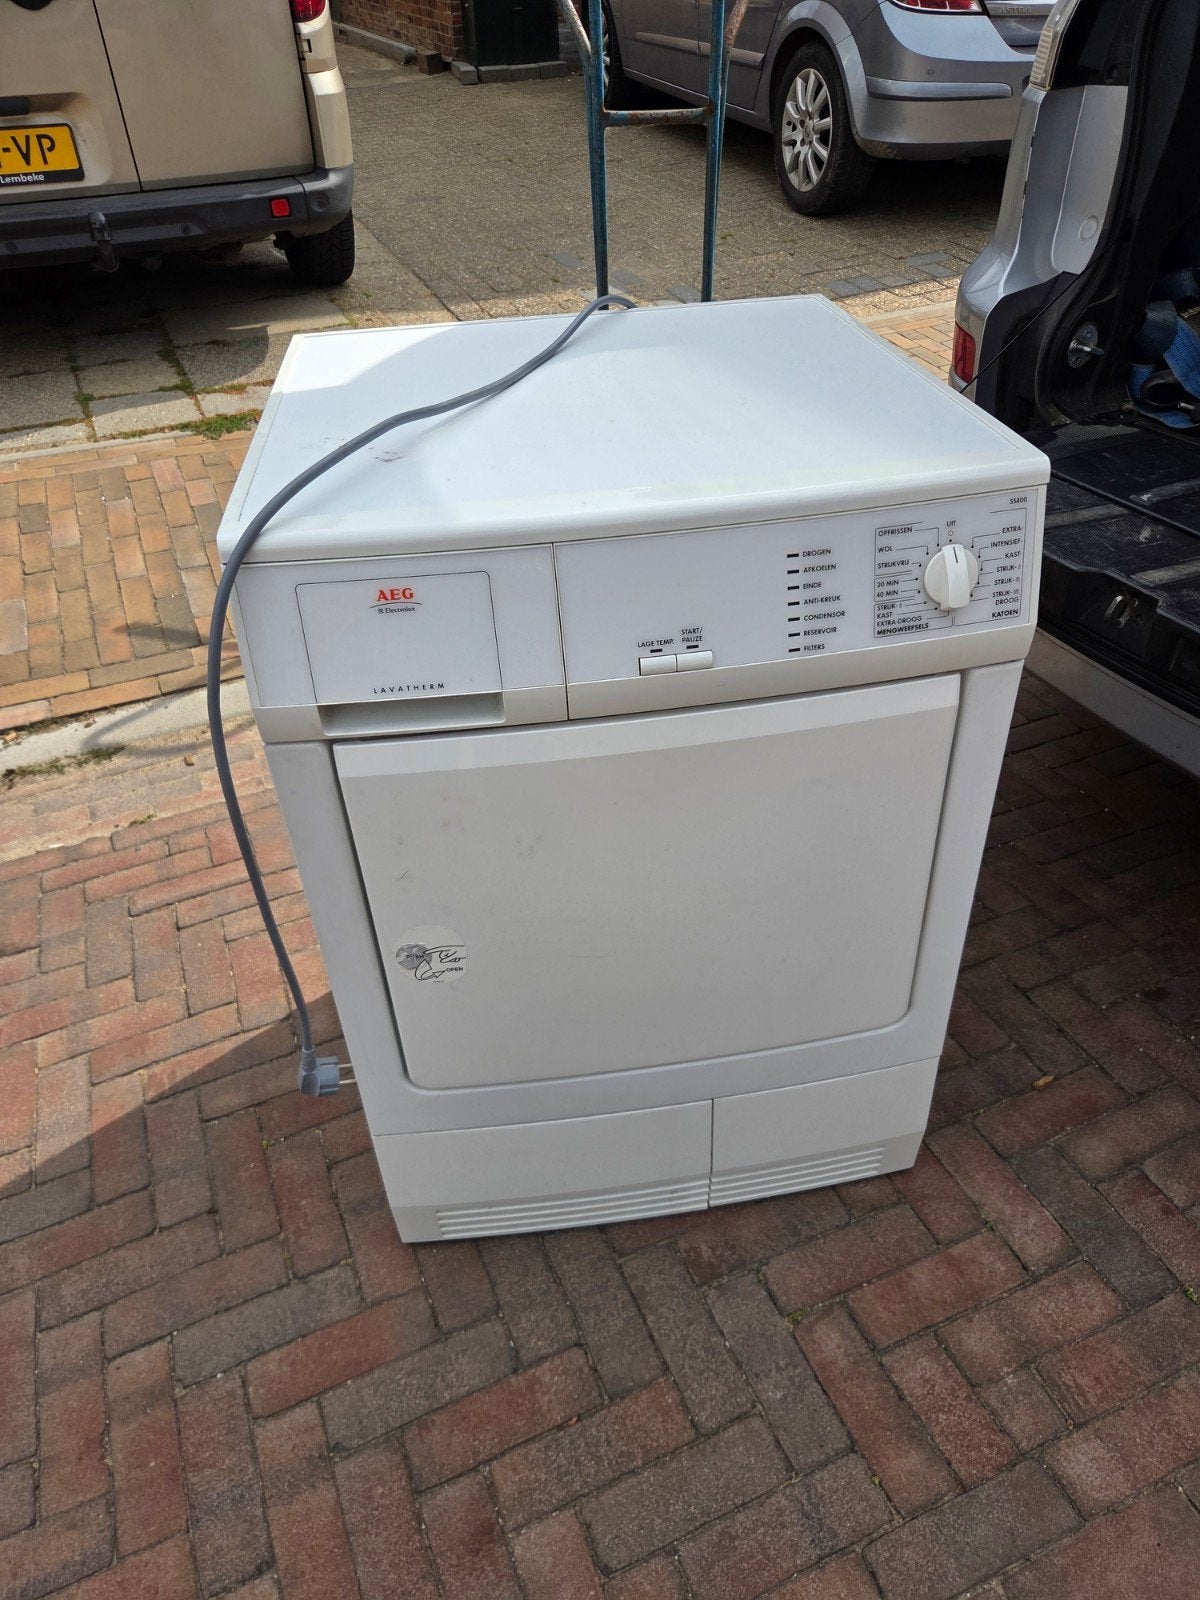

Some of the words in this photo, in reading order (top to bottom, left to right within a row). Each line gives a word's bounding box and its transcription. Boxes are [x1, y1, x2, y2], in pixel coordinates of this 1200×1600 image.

[0, 133, 56, 168] -VP
[0, 173, 45, 184] Lembeke
[878, 526, 913, 537] OPFRISSEN
[802, 548, 832, 558] DROGEN
[877, 545, 893, 553] WOL
[803, 563, 837, 573] AFKOELEN
[803, 581, 822, 590] EINDE
[377, 587, 415, 602] AEG
[886, 589, 899, 597] MIN
[803, 595, 841, 606] ANTI-KREUK
[995, 596, 1020, 606] DROOG
[385, 606, 416, 614] Electrolux
[991, 608, 1019, 619] KATOEN
[803, 610, 846, 622] CONDENSOR
[681, 627, 703, 636] START/
[803, 626, 837, 637] RESERVOIR
[876, 622, 930, 636] MENGWEEFSELS
[637, 640, 655, 648] LAGE
[656, 638, 675, 646] TEMP.
[681, 635, 703, 643] PAUZE
[803, 643, 826, 652] FILTERS
[373, 682, 446, 694] LAVATHERM
